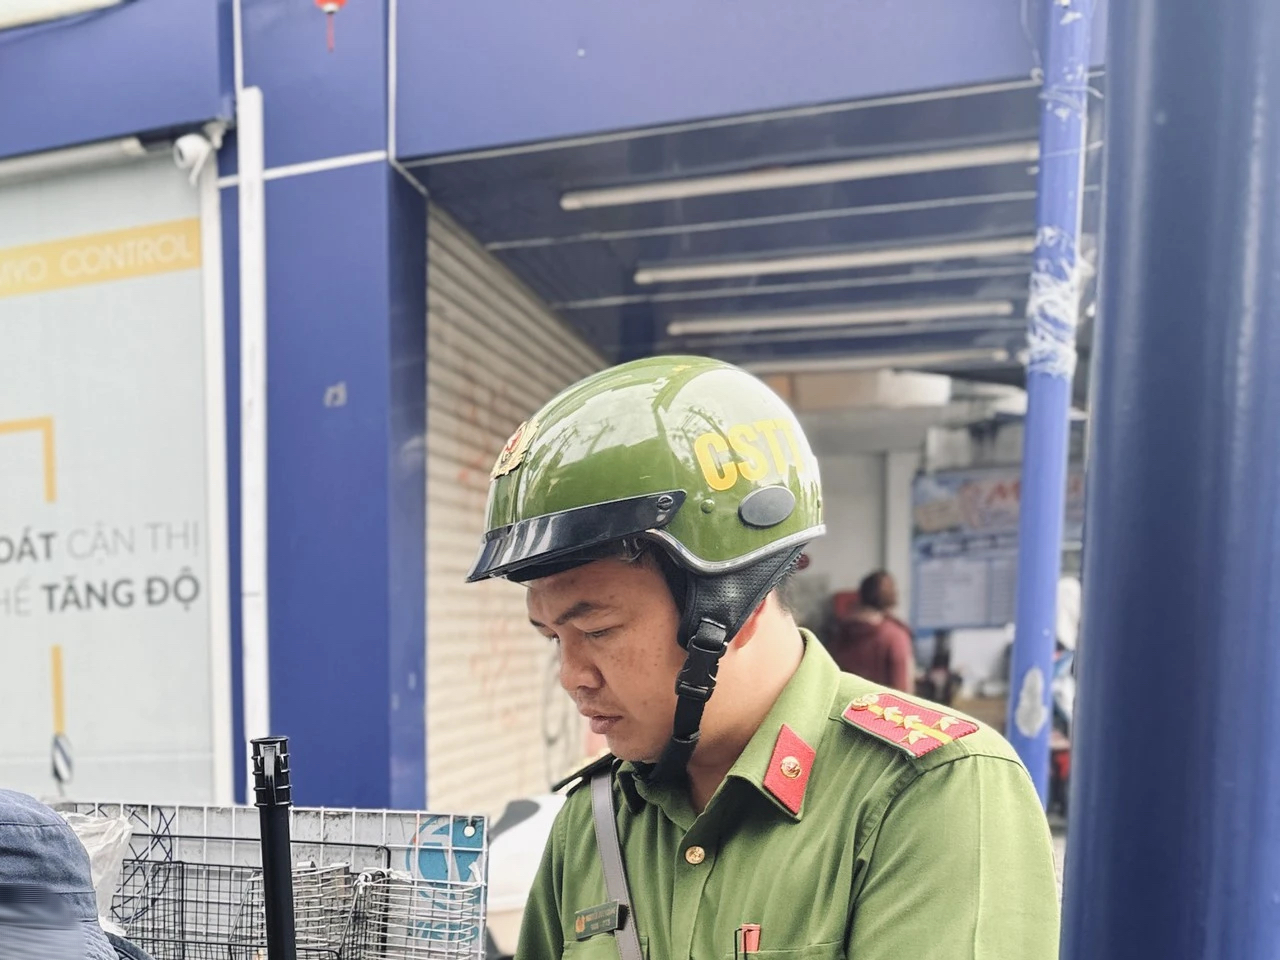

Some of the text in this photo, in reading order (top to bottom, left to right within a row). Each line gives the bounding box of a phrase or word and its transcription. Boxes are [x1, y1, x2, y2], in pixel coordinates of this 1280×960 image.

[59, 233, 193, 278] CONTROL
[39, 574, 136, 613] TĂNG
[144, 565, 202, 612] ĐỘ
